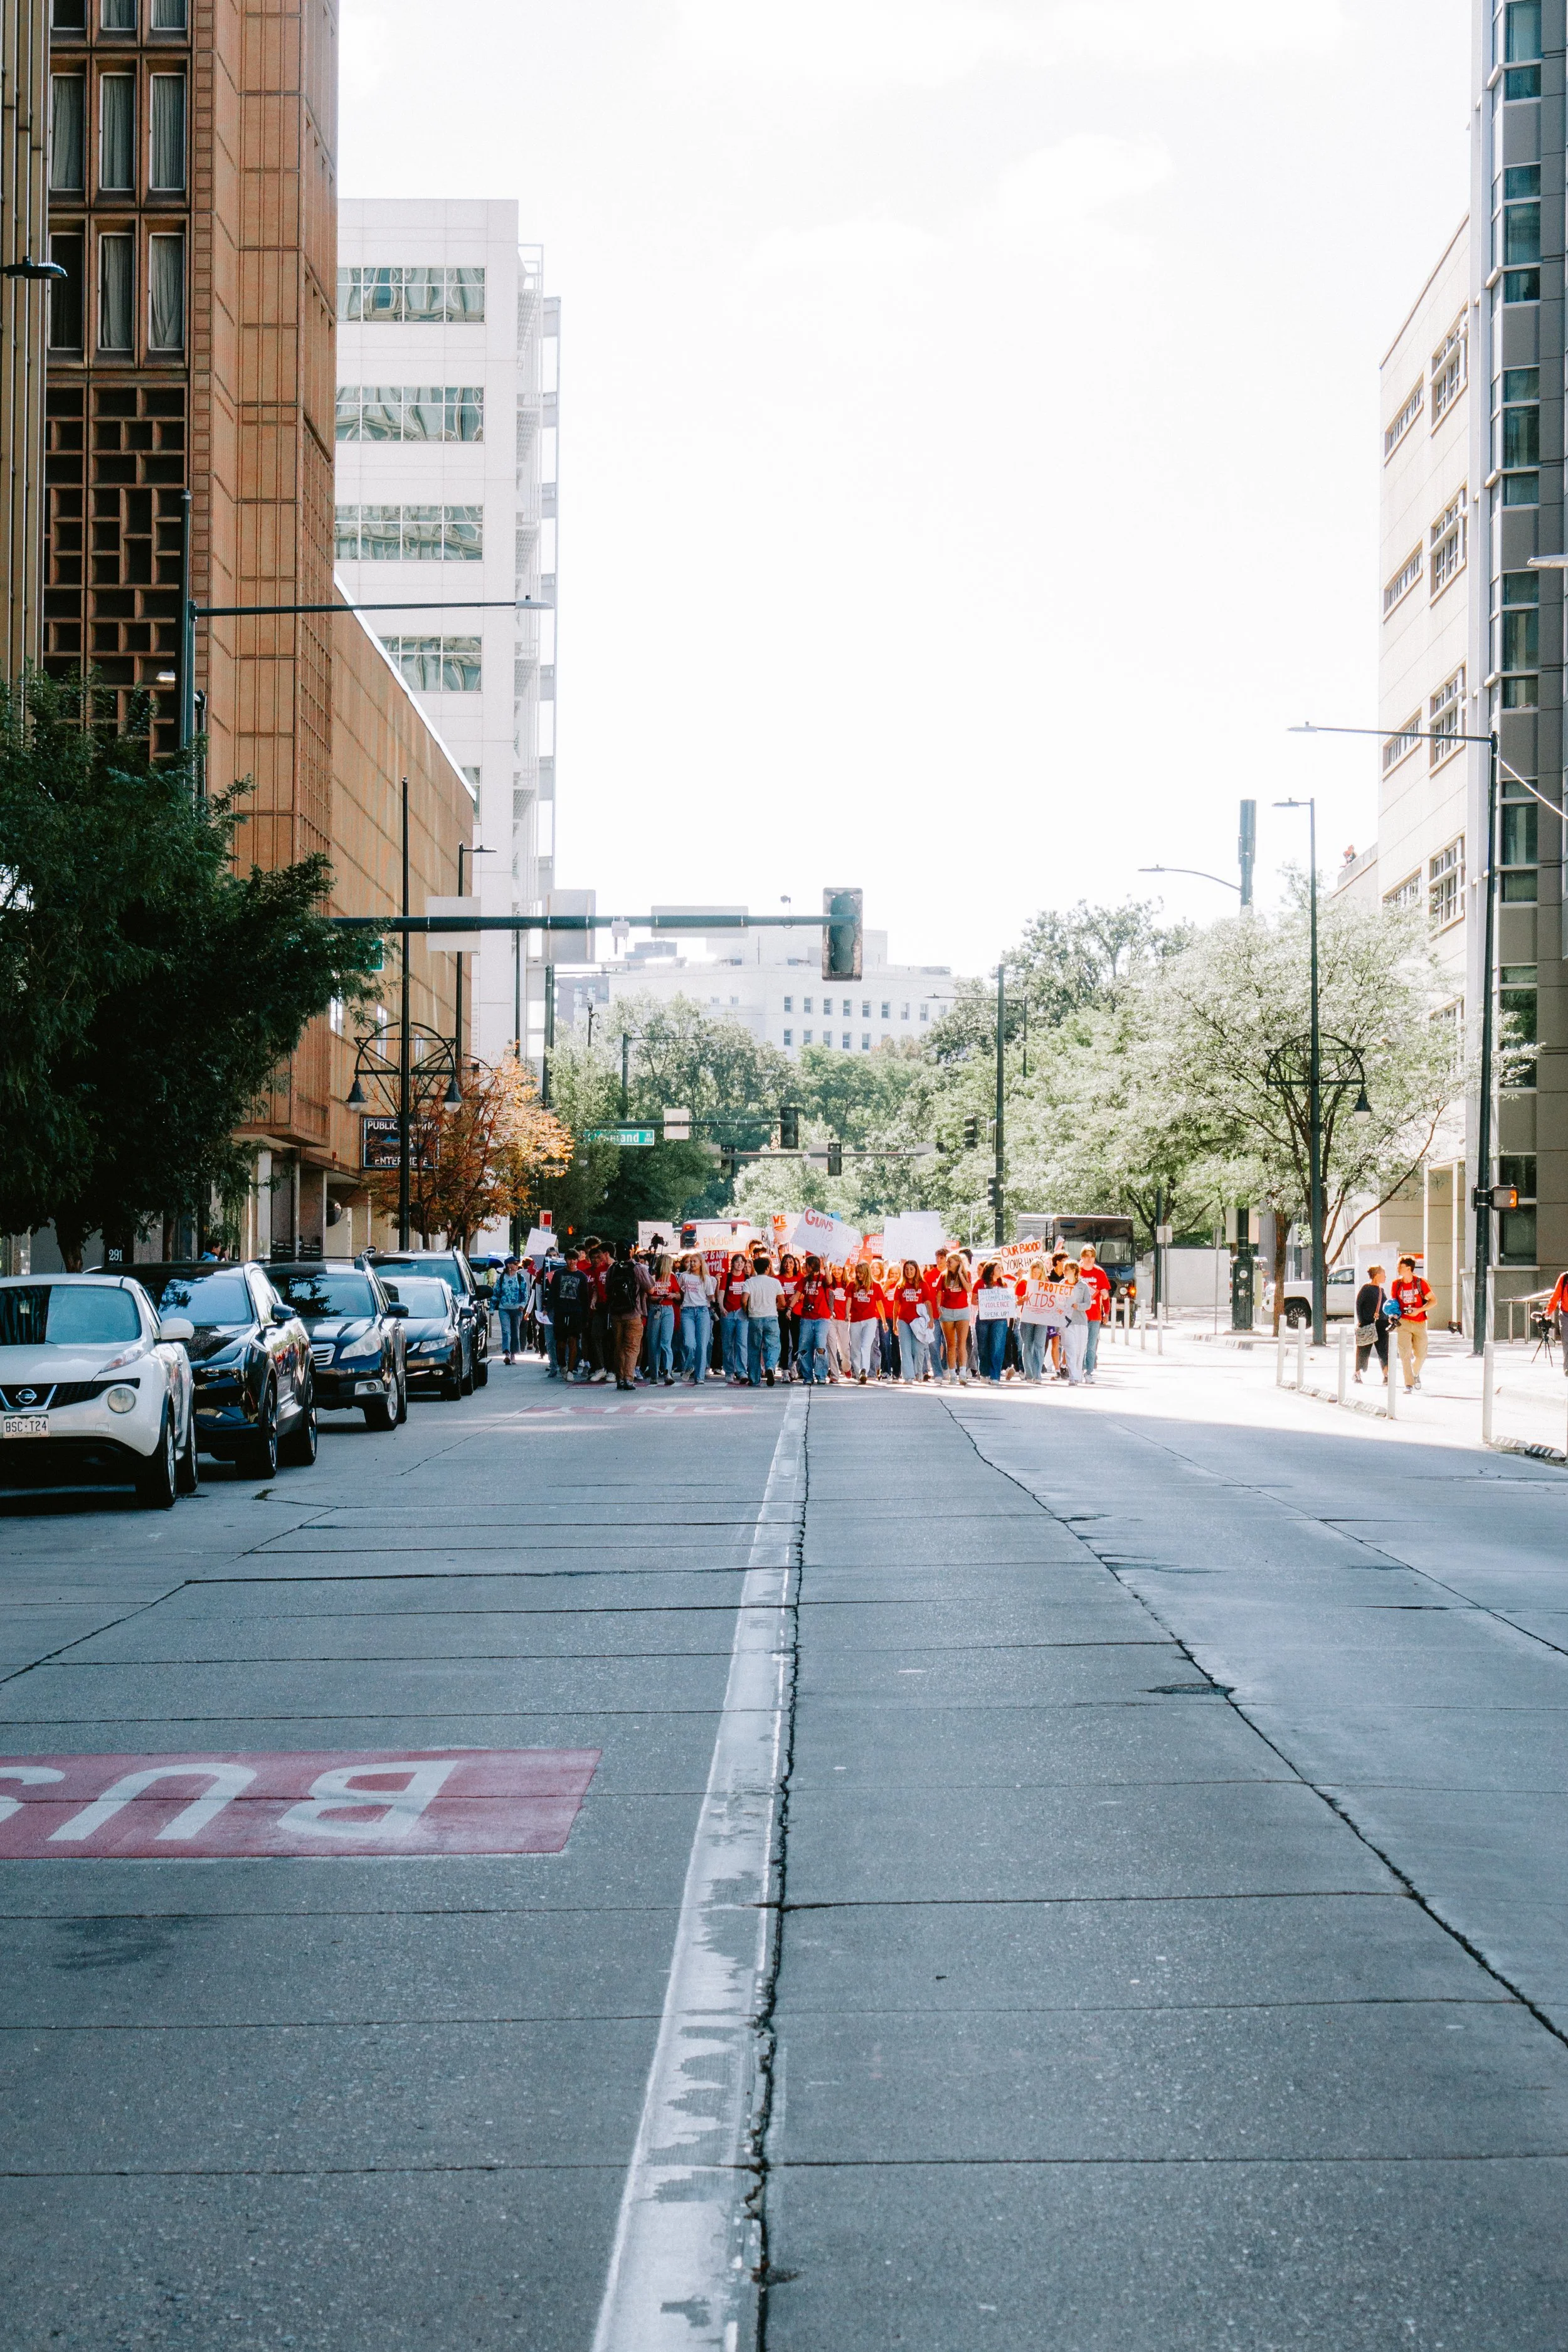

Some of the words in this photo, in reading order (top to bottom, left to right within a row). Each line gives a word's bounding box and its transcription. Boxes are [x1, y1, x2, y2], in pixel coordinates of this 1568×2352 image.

[368, 1121, 398, 1130] PUBLIC
[773, 1215, 786, 1225] WE
[805, 1208, 834, 1232] GUNS
[703, 1236, 734, 1247] ENOUGH
[109, 1249, 122, 1261] 291
[710, 1251, 715, 1260] IS
[716, 1250, 727, 1259] NOT
[1001, 1245, 1019, 1258] OUR
[1019, 1241, 1041, 1254] BLOOD
[1004, 1258, 1024, 1271] YOUR
[1038, 1281, 1074, 1296] PROTECT
[1026, 1291, 1056, 1308] KIDS
